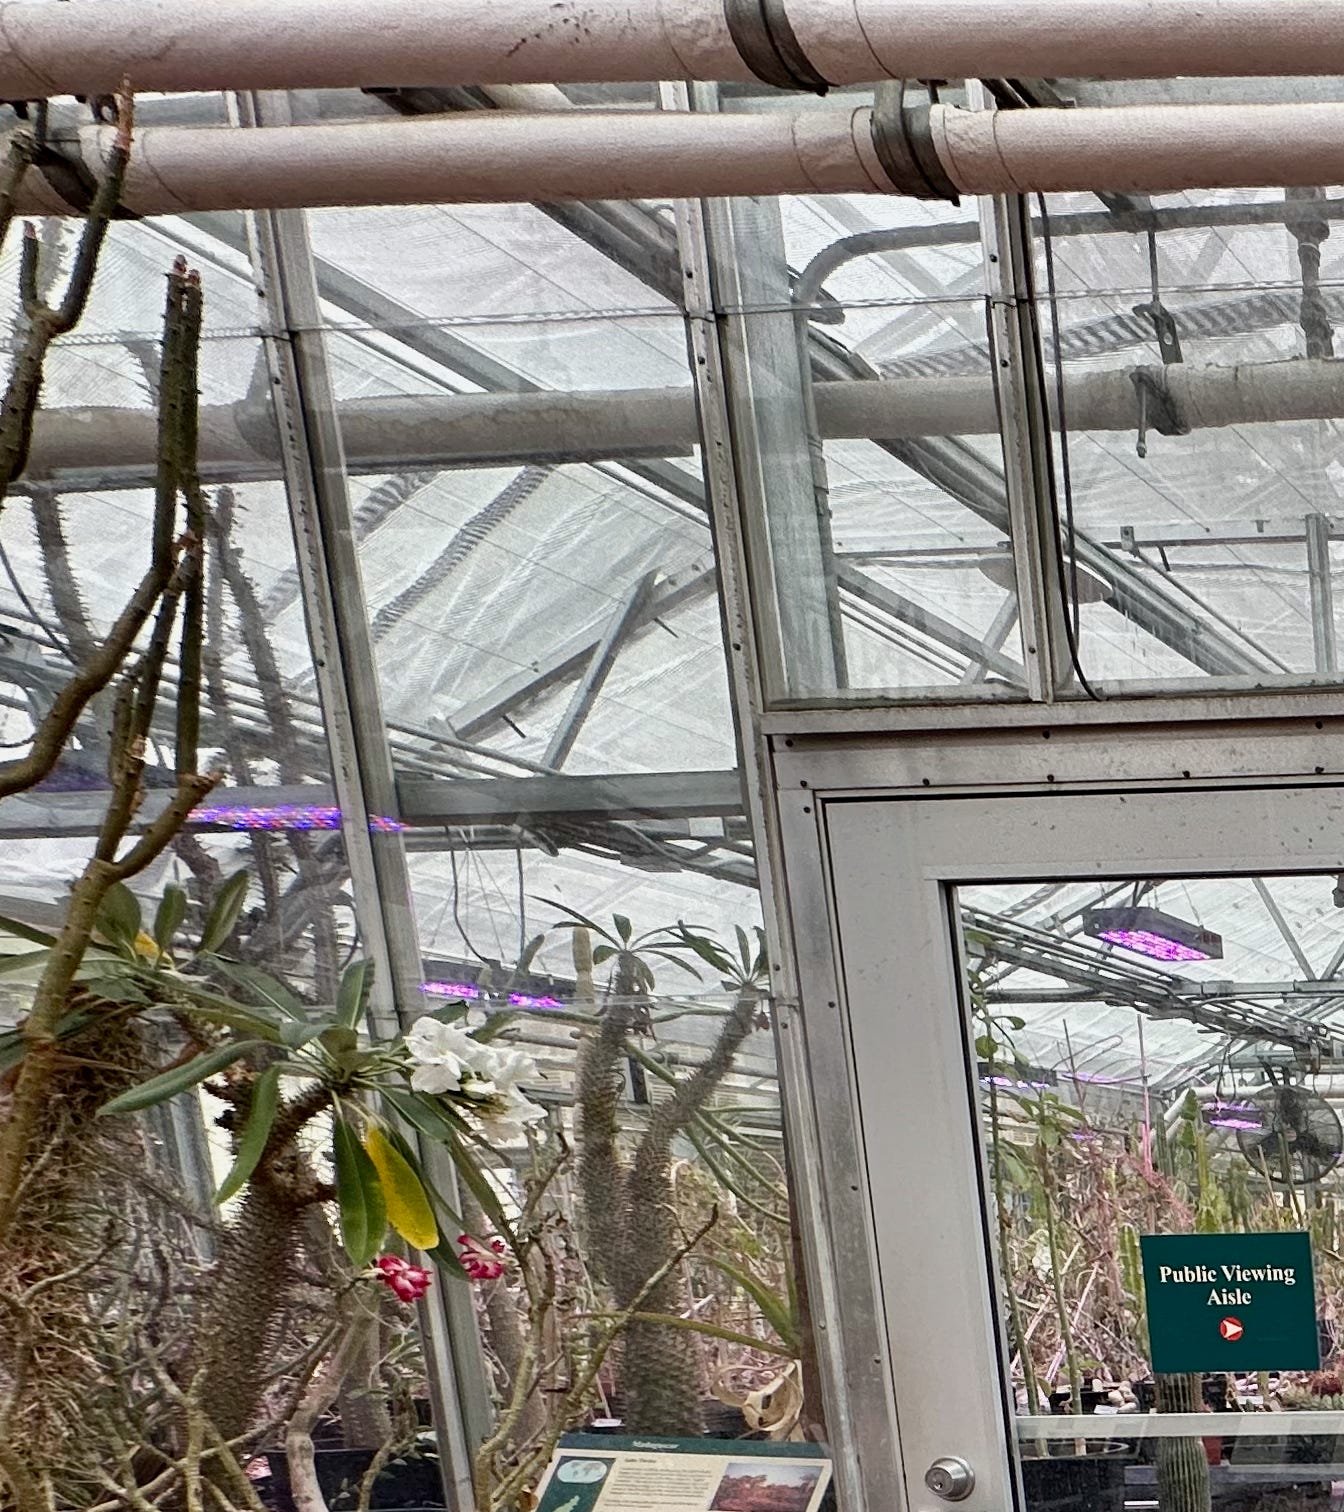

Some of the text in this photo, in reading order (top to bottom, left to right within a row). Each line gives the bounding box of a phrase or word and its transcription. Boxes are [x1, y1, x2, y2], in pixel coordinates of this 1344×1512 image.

[1159, 1264, 1296, 1286] Public Viewing
[1207, 1288, 1252, 1305] Aisle
